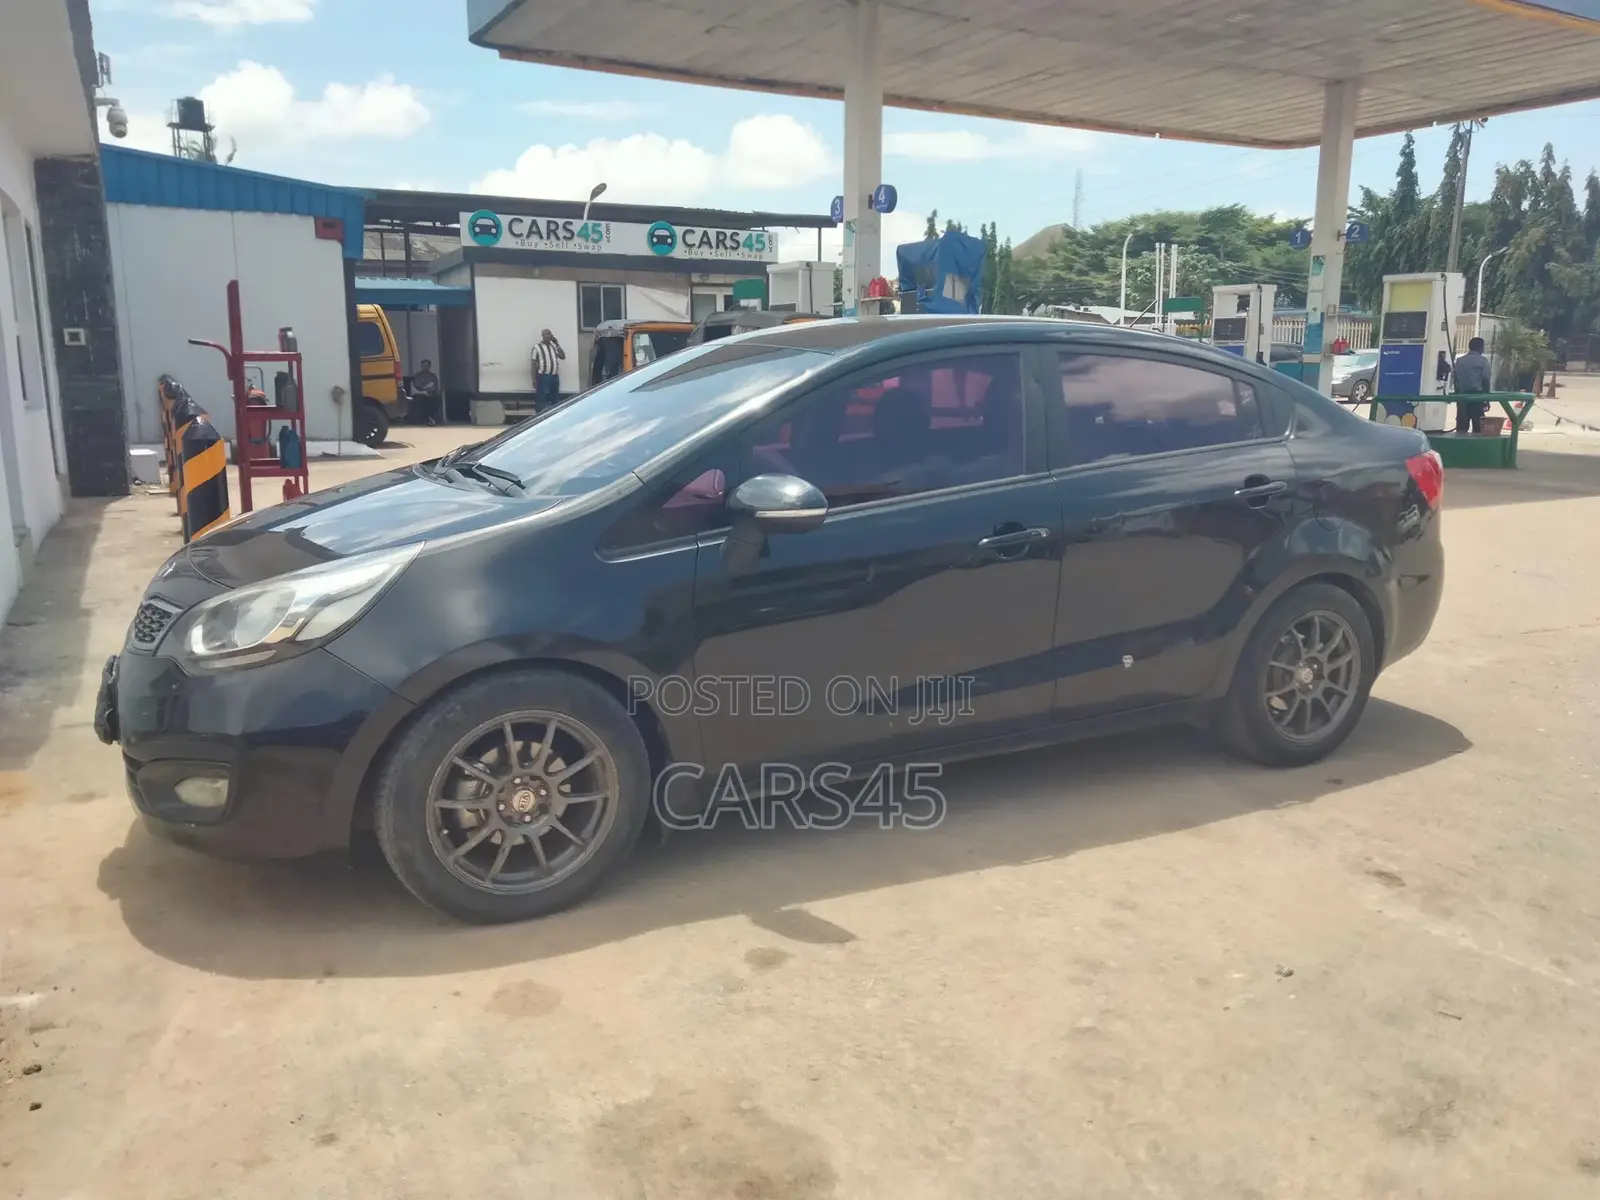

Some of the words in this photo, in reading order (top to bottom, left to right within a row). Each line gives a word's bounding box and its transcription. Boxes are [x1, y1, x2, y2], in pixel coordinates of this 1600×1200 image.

[878, 187, 886, 204] 4
[834, 199, 841, 215] 3
[507, 217, 604, 243] CARS45
[1295, 231, 1302, 244] 1
[1350, 225, 1360, 238] 2
[682, 228, 766, 252] CARS45
